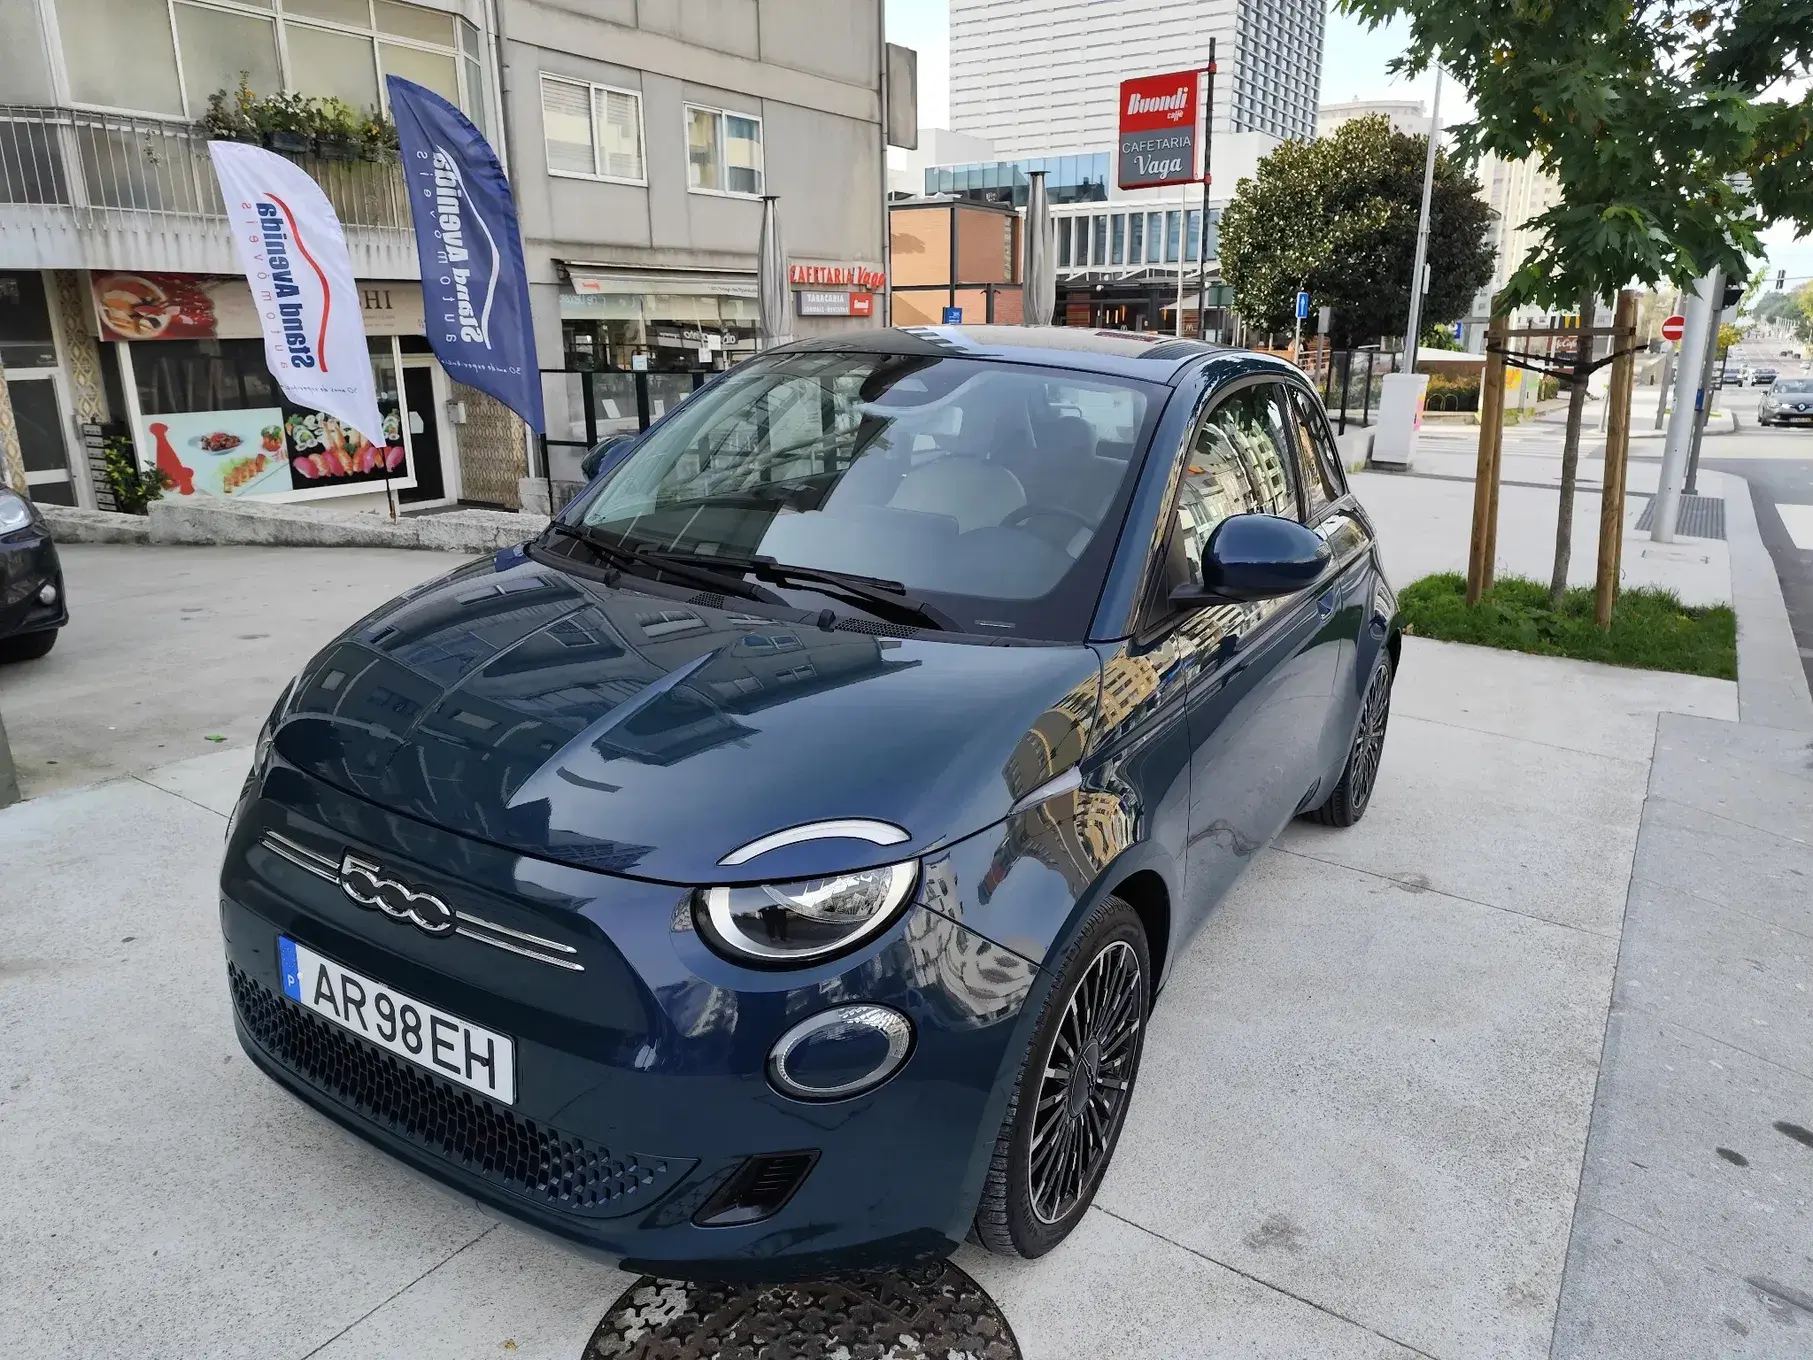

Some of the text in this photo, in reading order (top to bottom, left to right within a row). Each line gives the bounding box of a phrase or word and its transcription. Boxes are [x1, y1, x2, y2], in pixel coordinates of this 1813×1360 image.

[1127, 87, 1188, 115] Buondi
[1122, 136, 1191, 153] CAFETARIA
[1134, 154, 1183, 180] Vaga
[790, 264, 886, 291] CAFETARIA Vaga
[360, 290, 393, 310] HI
[341, 854, 451, 932] 500
[287, 974, 295, 987] P
